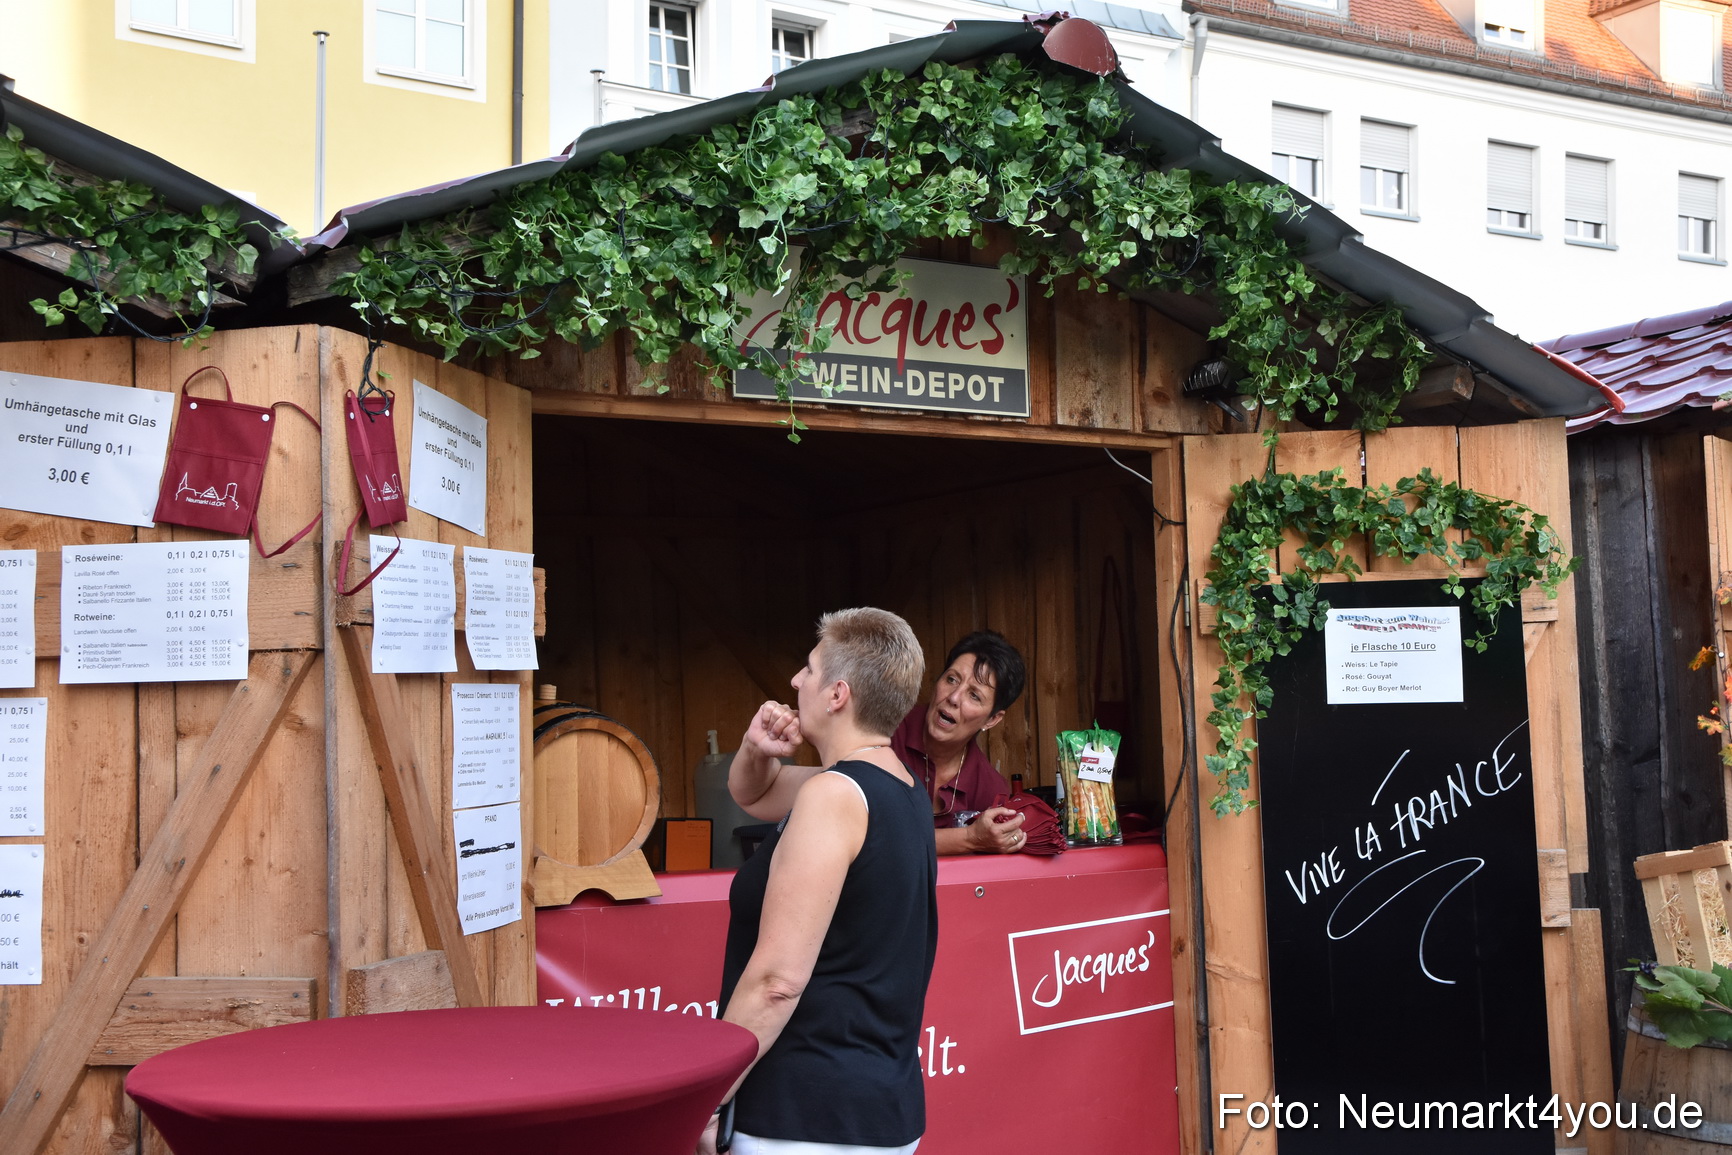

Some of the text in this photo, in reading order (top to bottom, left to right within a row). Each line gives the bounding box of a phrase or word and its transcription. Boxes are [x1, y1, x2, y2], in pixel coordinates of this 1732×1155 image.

[811, 361, 1005, 402] WEIN-DEPOT
[4, 398, 157, 428] Umhängetasche mit Glas
[65, 424, 89, 434] und
[418, 406, 482, 448] Umhängetasche mit Glas
[18, 433, 54, 446] erster
[57, 436, 102, 455] Füllung
[105, 442, 123, 456] 0,1
[447, 437, 457, 448] und
[425, 442, 443, 455] erster
[444, 448, 463, 468] Füllung
[48, 468, 90, 485] 3,00 €
[441, 476, 461, 495] 3,00 €
[75, 554, 123, 562] Roséweine:
[167, 551, 179, 560] 0,1
[190, 551, 203, 560] 0,2
[212, 550, 230, 559] 0,75
[74, 613, 115, 621] Rotweine:
[166, 611, 178, 619] 0,1
[189, 610, 201, 619] 0,2
[210, 609, 228, 618] 0,75
[1351, 642, 1436, 652] je Flasche 10 Euro
[1380, 661, 1398, 669] Tapie
[1367, 673, 1392, 681] Gouyat
[1362, 685, 1376, 693] Guy
[1377, 685, 1398, 693] Boyer
[11, 707, 28, 716] 0,75
[1285, 846, 1345, 904] VIVE
[1355, 822, 1382, 860] LA
[1032, 930, 1155, 1008] Jacques'
[917, 1026, 966, 1078] lt.
